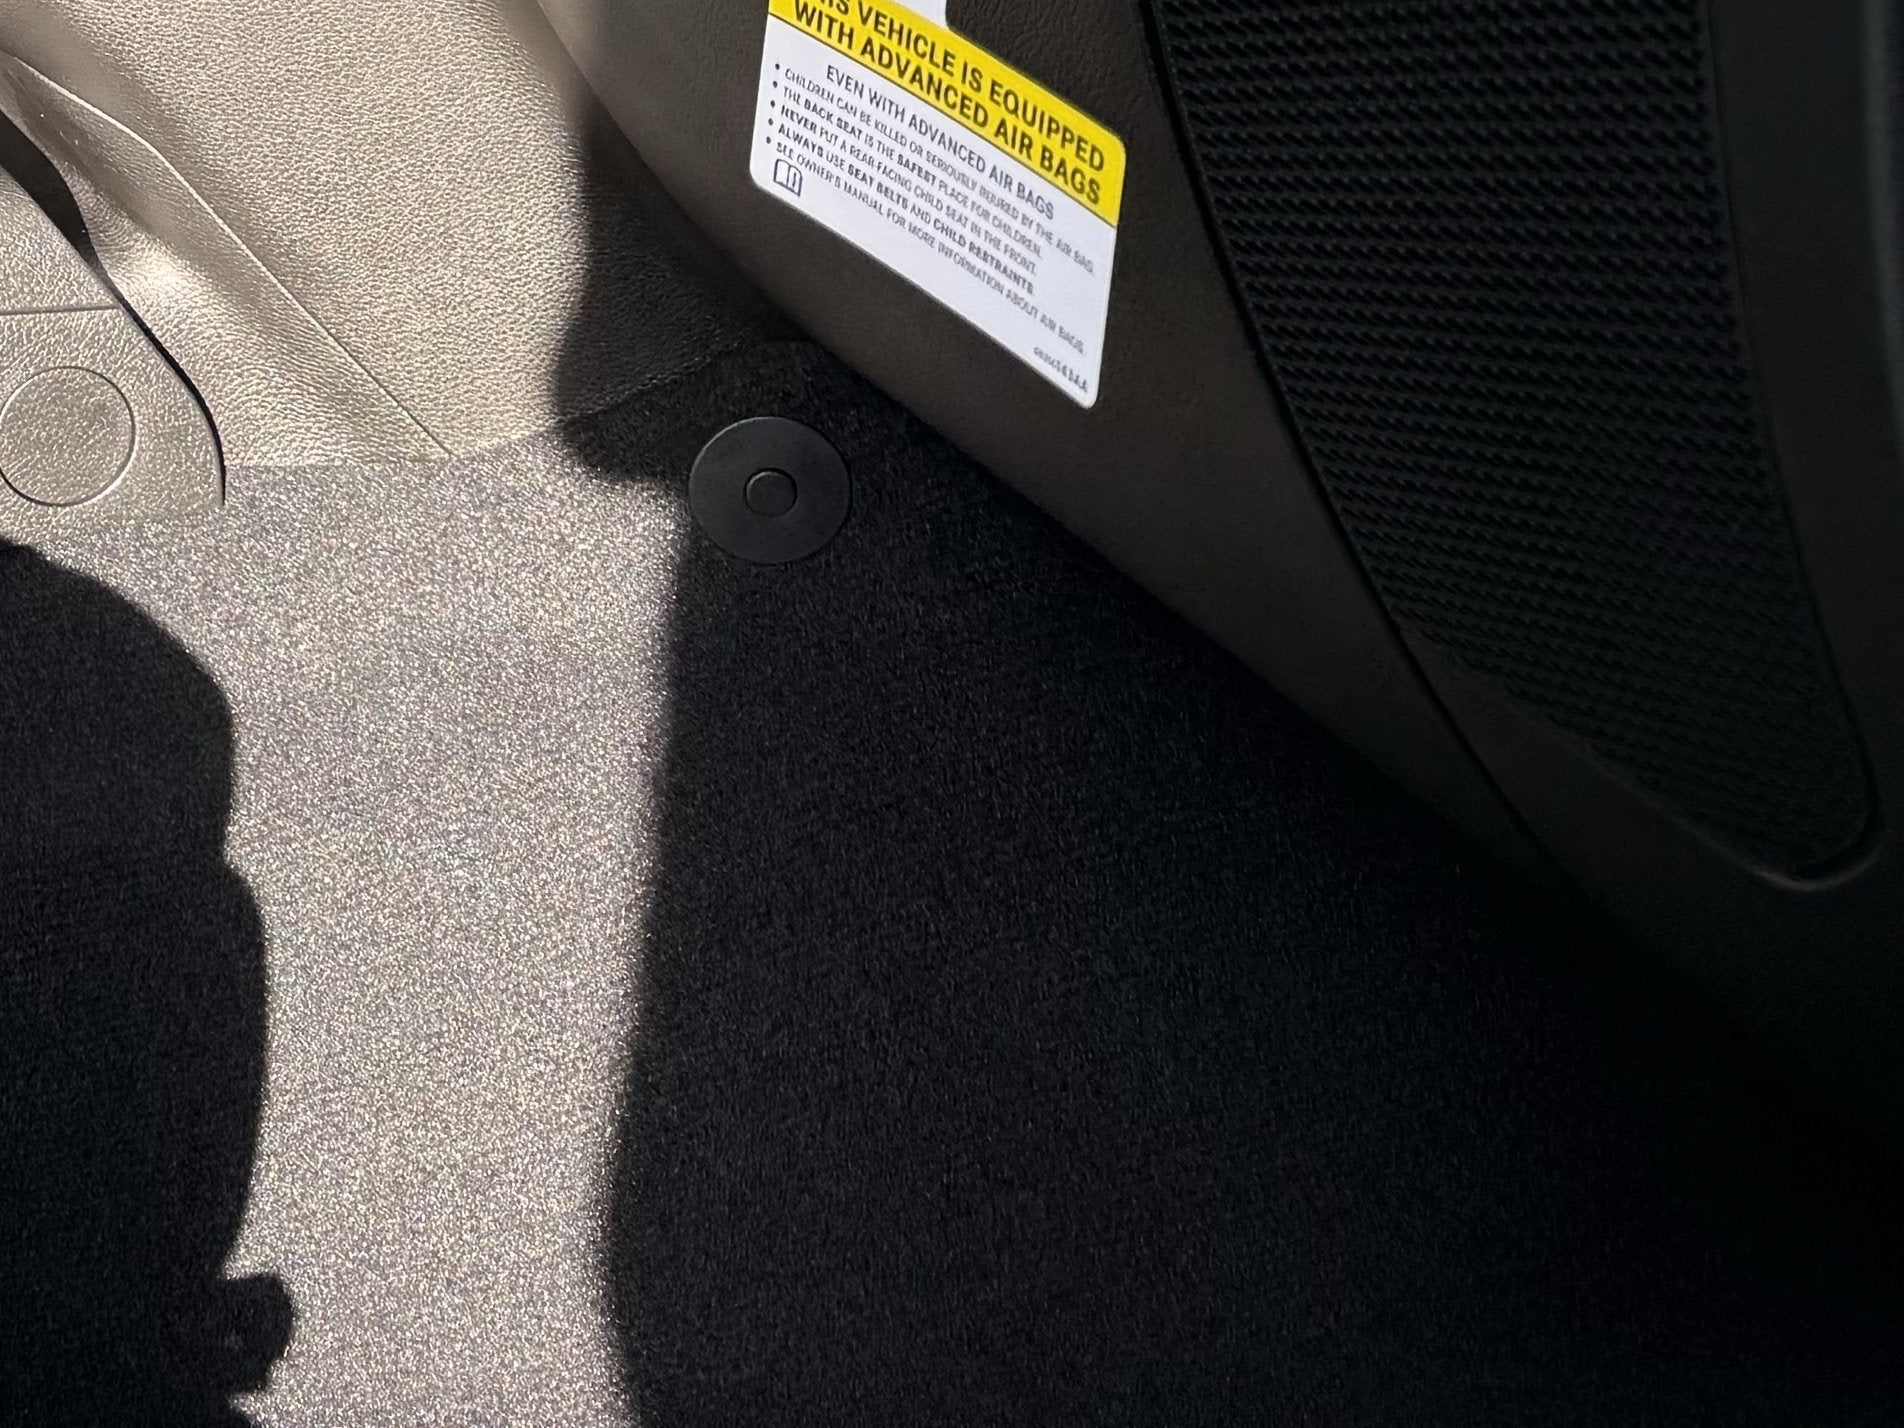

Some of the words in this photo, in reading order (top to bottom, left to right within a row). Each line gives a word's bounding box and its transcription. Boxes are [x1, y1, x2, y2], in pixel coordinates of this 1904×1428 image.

[783, 85, 800, 105] THE
[804, 97, 833, 124] BACK
[836, 116, 861, 141] SEAT
[864, 132, 873, 148] IS
[876, 140, 895, 161] THE
[897, 152, 936, 187] SAFEST
[938, 178, 968, 208] PLACE
[970, 199, 991, 223] FOR
[785, 66, 834, 105] CHILDREN
[836, 96, 857, 118] CAN
[859, 110, 871, 126] BE
[874, 118, 906, 147] KILLED
[909, 139, 923, 157] OR
[1035, 222, 1053, 245] THE
[826, 63, 864, 99] EVEN
[867, 87, 905, 124] WITH
[908, 112, 986, 174] ADVANCED
[988, 162, 1012, 193] AIR
[1016, 181, 1054, 221] BAGS
[856, 0, 956, 77] VEHICLE
[960, 60, 983, 95] IS
[989, 78, 1105, 175] EQUIPPED
[860, 33, 989, 131] ADVANCED
[994, 114, 1034, 161] AIR
[1039, 144, 1100, 206] BAGS
[776, 140, 793, 160] SEE
[843, 181, 883, 215] MANUAL
[886, 208, 905, 229] FOR
[908, 221, 935, 249] MORE
[778, 122, 823, 158] ALWAYS
[825, 150, 845, 171] USE
[847, 163, 873, 189] SEAT
[876, 181, 908, 210] BELTS
[910, 201, 930, 225] AND
[933, 216, 966, 248] CHILD
[780, 104, 816, 134] NEVER
[819, 126, 838, 147] PUT
[840, 138, 847, 153] A
[913, 183, 943, 213] CHILD
[945, 203, 967, 229] SEAT
[970, 220, 981, 238] IN
[983, 229, 1001, 251] THE
